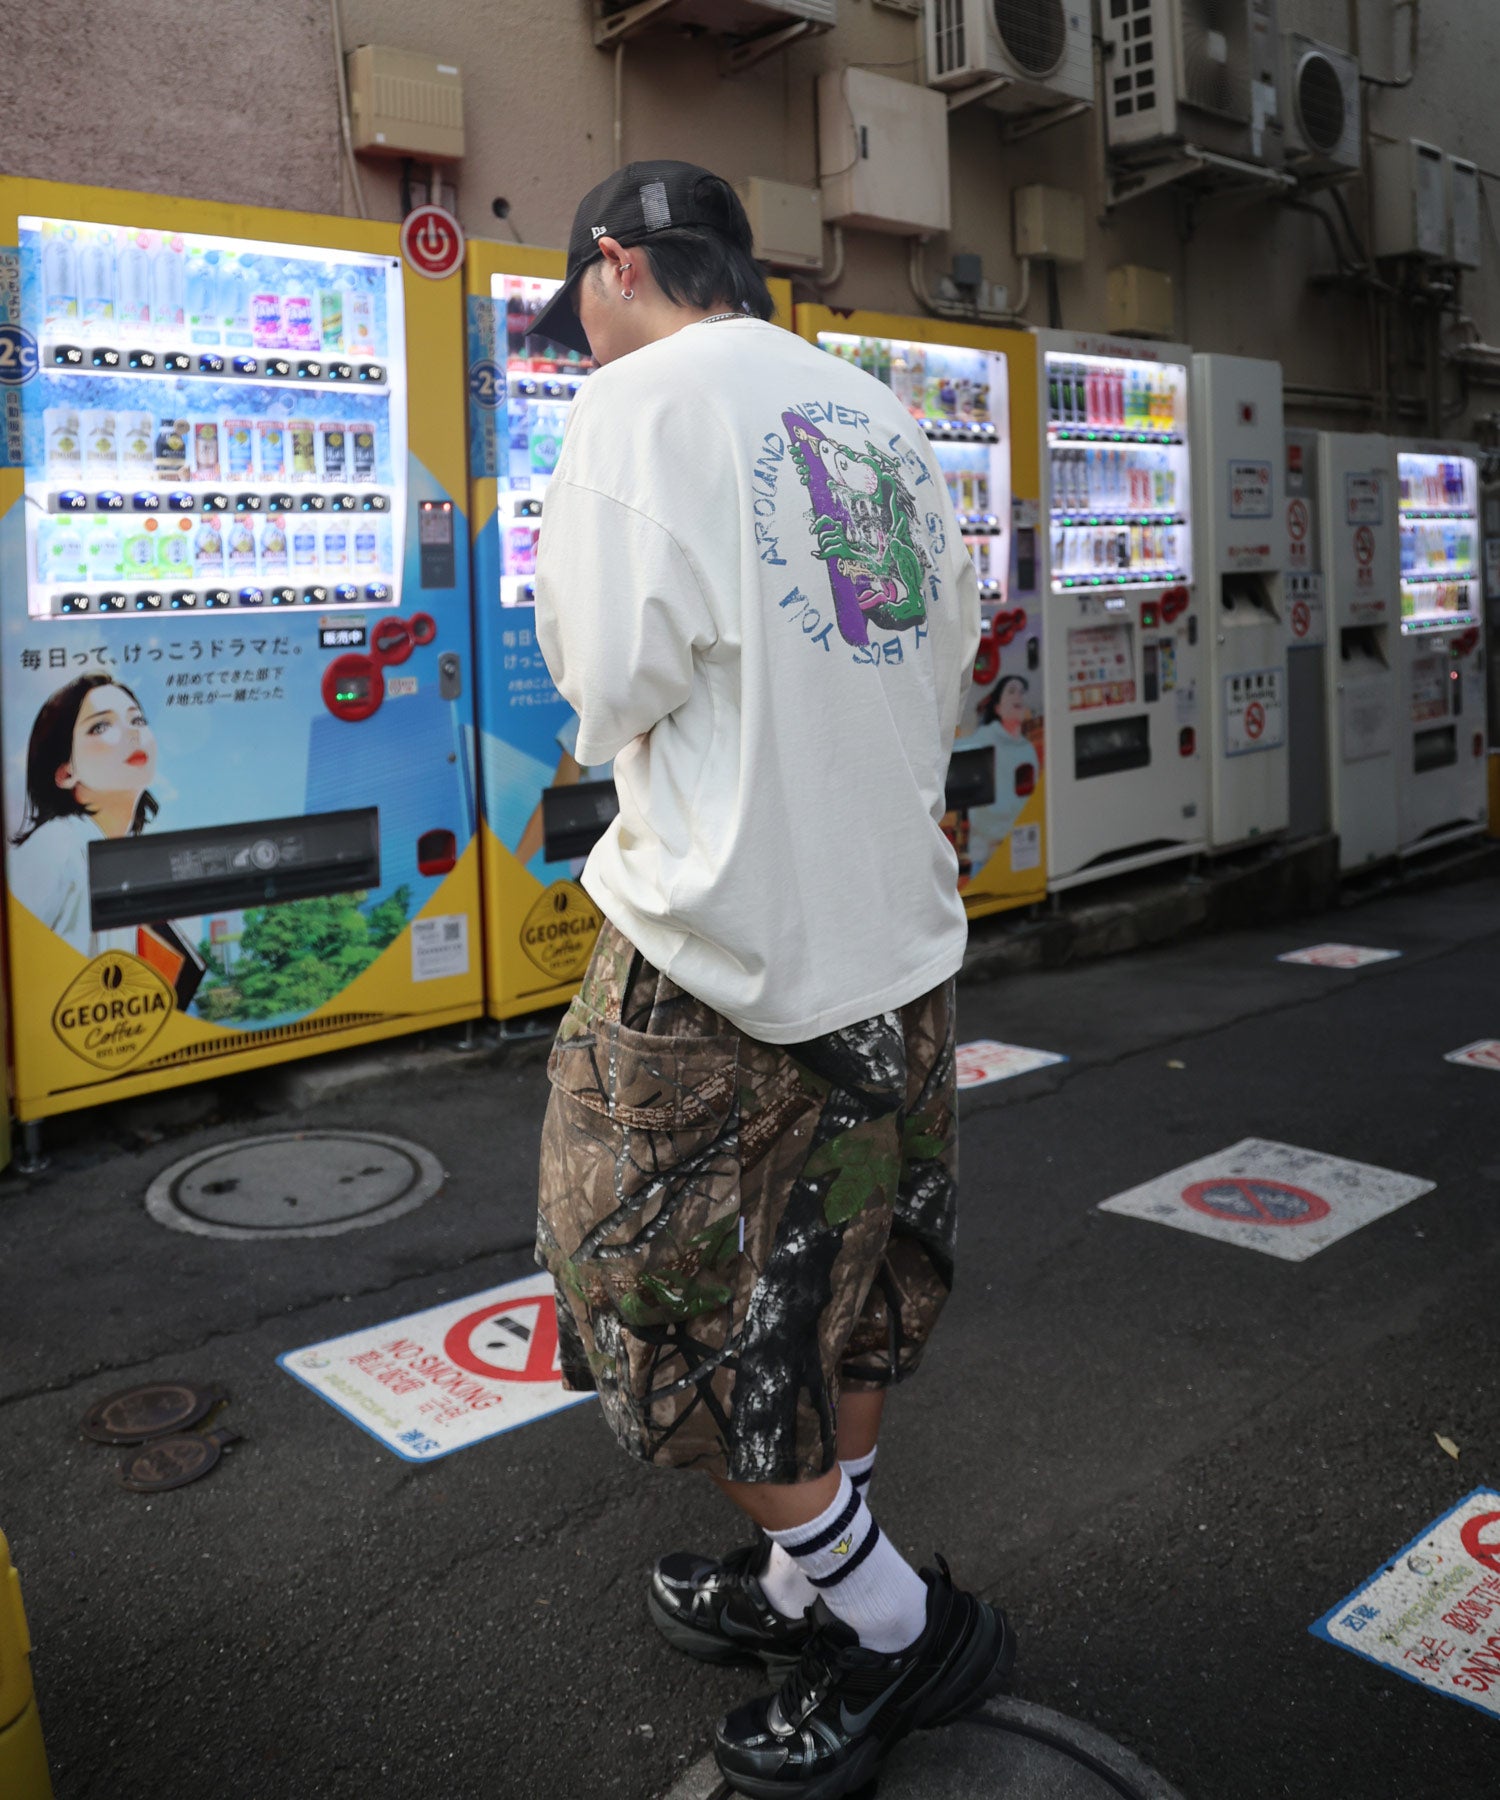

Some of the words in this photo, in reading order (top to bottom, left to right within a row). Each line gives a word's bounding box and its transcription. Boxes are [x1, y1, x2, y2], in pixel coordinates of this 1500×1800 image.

[6, 391, 23, 463] 自動販売機
[787, 400, 871, 434] NEVER
[753, 432, 788, 567] AROUND
[525, 916, 597, 945] GEORGIA
[61, 992, 166, 1029] GEORGIA
[84, 1019, 145, 1050] Coffee
[382, 1337, 425, 1360] NO
[409, 1352, 503, 1412] SMOKING
[1339, 1603, 1382, 1633] 港区
